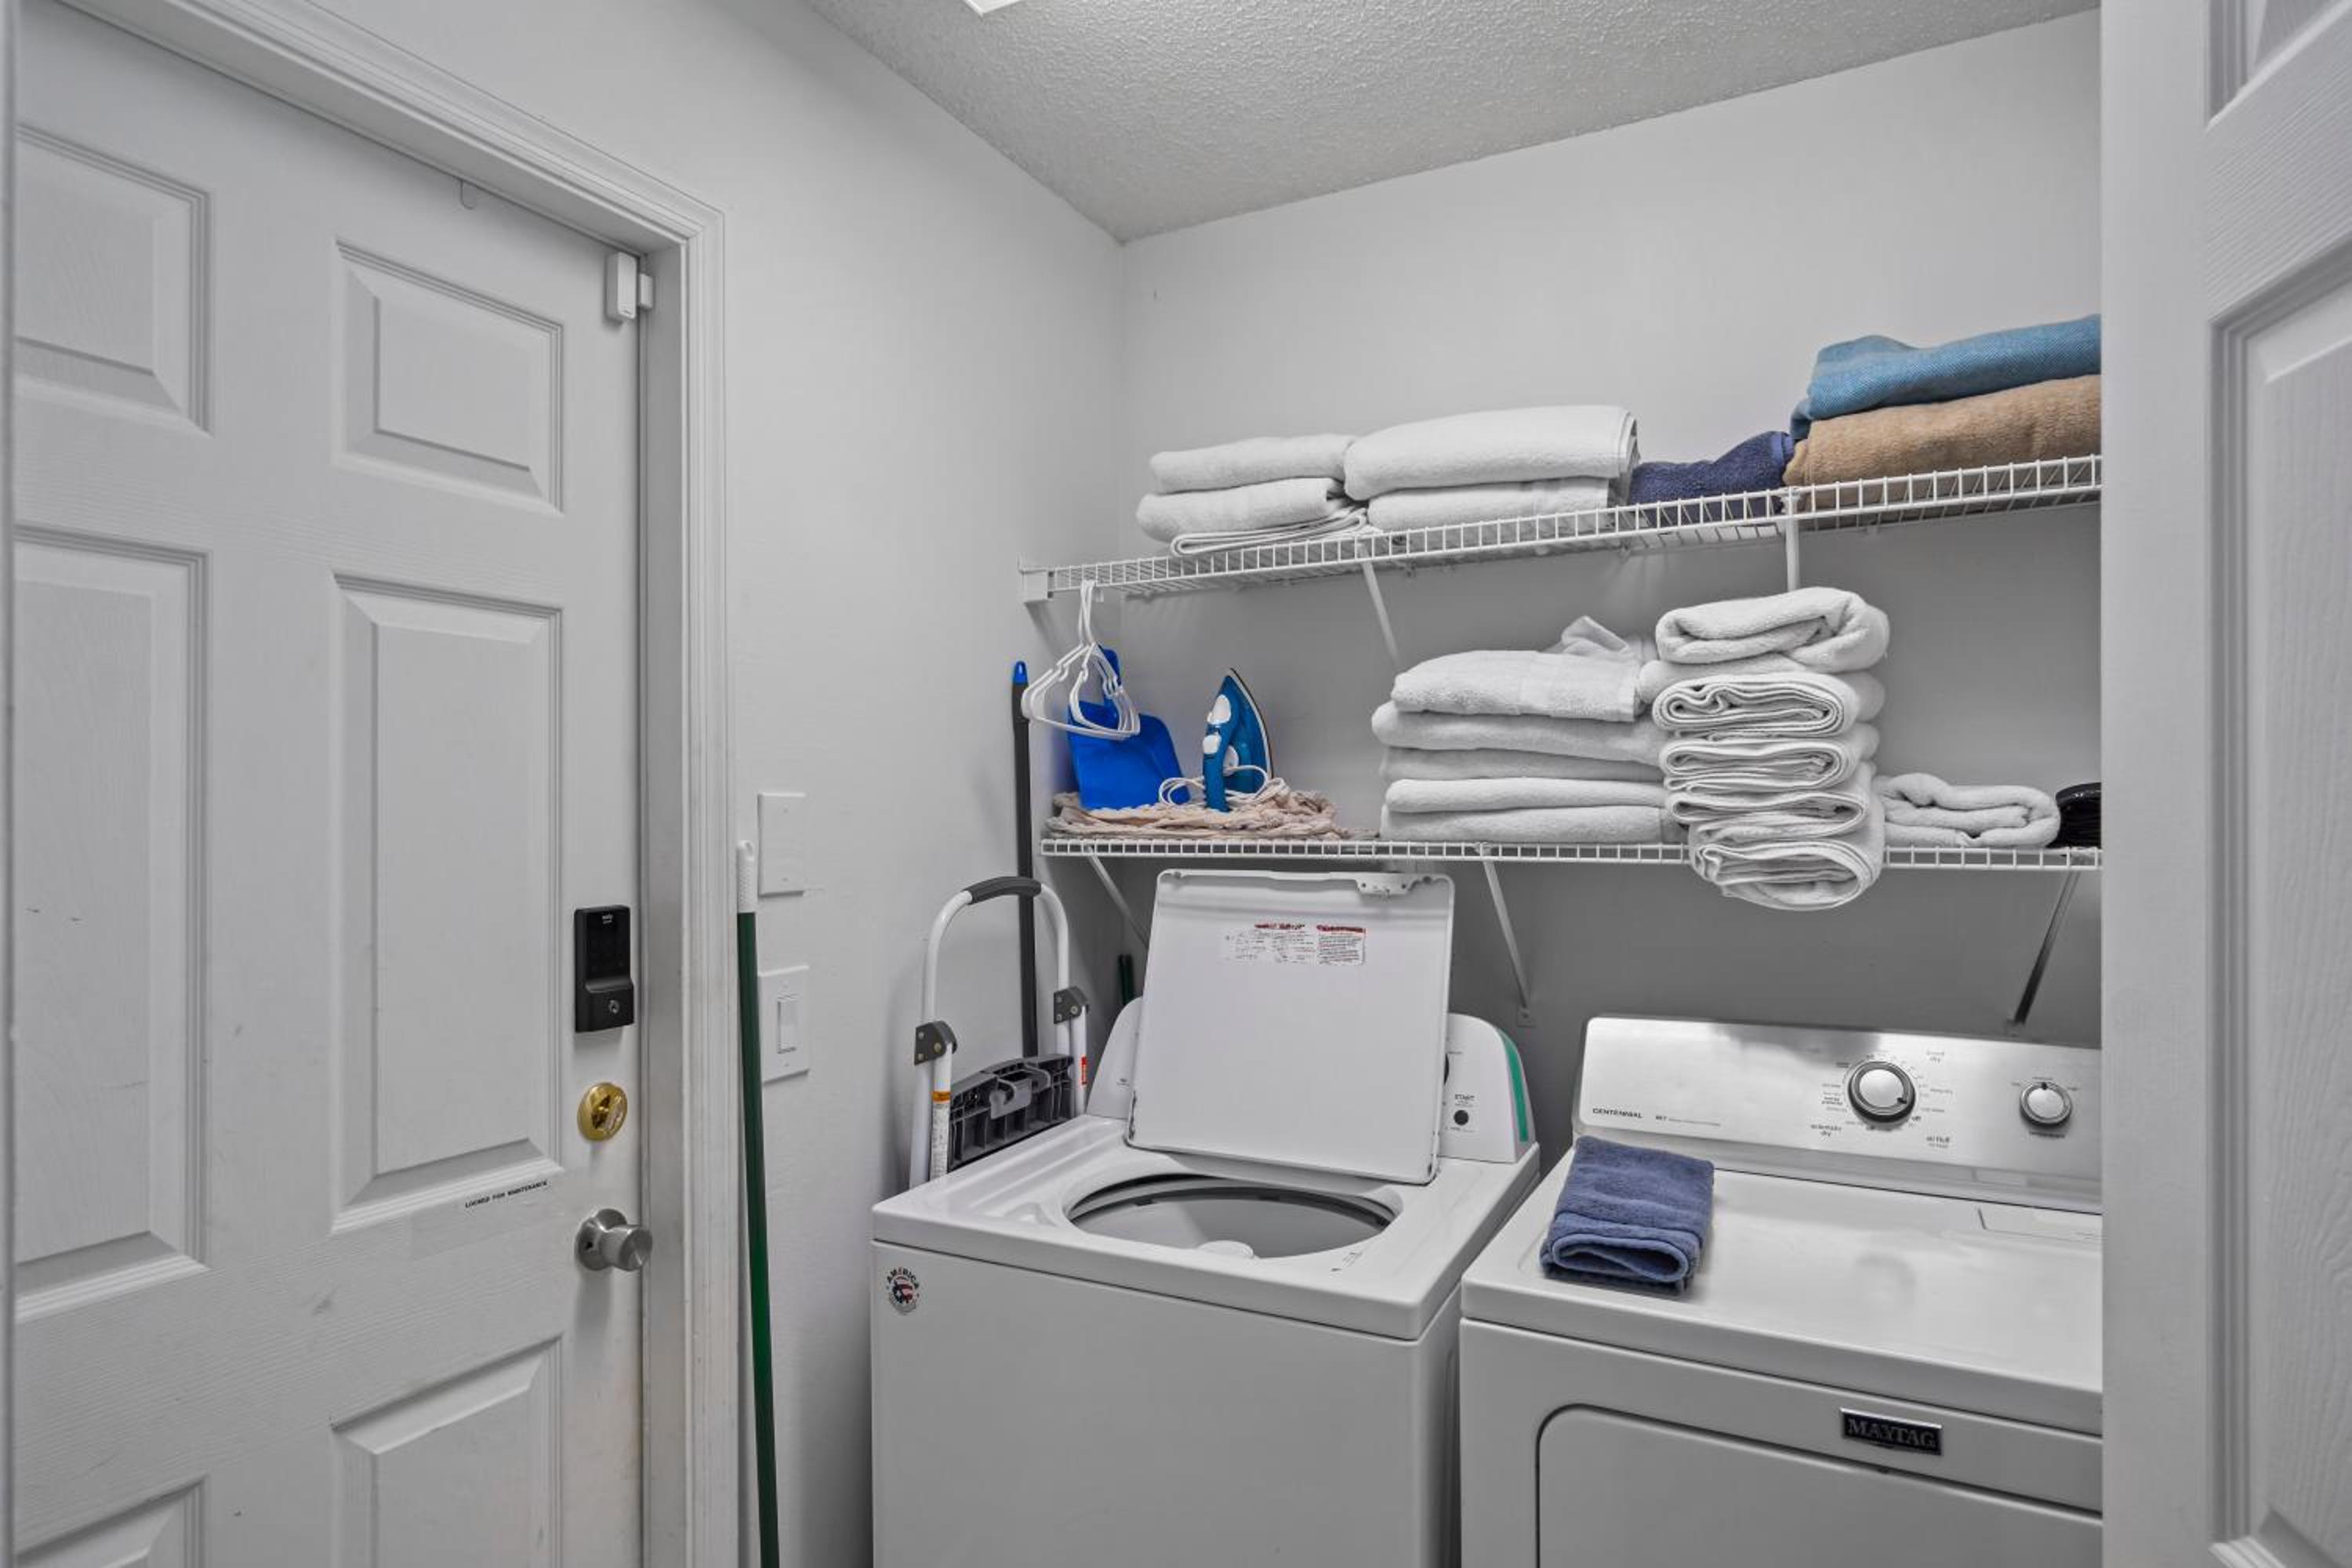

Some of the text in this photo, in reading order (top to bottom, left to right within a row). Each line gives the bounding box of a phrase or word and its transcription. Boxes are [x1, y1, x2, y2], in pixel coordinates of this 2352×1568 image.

[1592, 1107, 1643, 1119] CENTENNIAL
[507, 1180, 548, 1196] MAINTENANCE
[1848, 1417, 1936, 1450] MAYTAG
